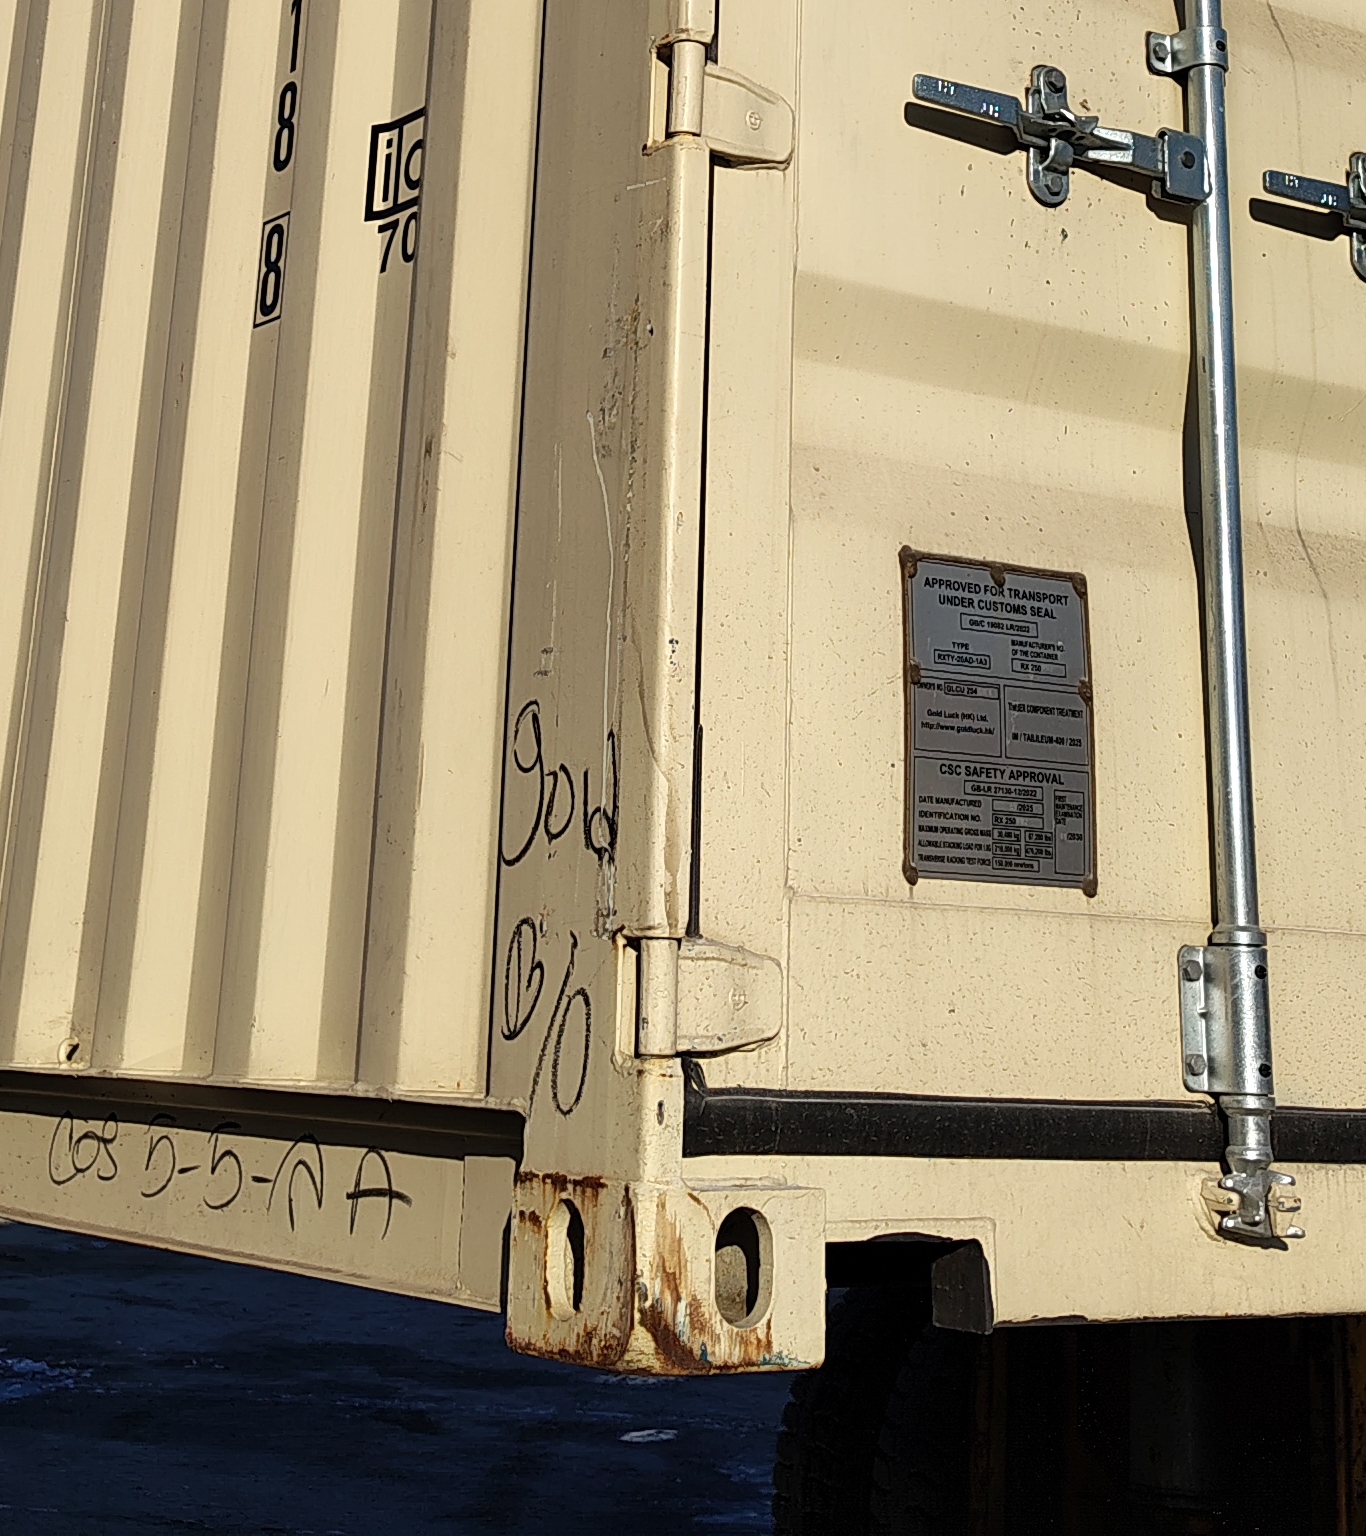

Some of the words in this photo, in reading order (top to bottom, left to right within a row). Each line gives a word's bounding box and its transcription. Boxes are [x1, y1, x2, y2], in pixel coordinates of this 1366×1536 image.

[258, 222, 285, 320] 8
[923, 576, 982, 594] APPROVED
[983, 584, 1006, 598] FOR
[1007, 588, 1069, 606] TRANSPORT
[938, 594, 975, 609] UNDER
[977, 599, 1028, 615] CUSTOMS
[1029, 606, 1057, 619] SEAL
[952, 641, 970, 651] TYPE
[1019, 649, 1029, 658] THE
[927, 709, 943, 718] Gold
[944, 710, 960, 720] Luck
[939, 763, 962, 776] CSC
[964, 766, 1006, 780] SAFETY
[1008, 769, 1064, 785] APPROVAL
[918, 795, 934, 805] DATE
[935, 796, 982, 808] MANUFACTURED
[918, 809, 970, 821] IDENTIFICATION
[971, 813, 982, 823] NO.
[994, 816, 1004, 824] RX
